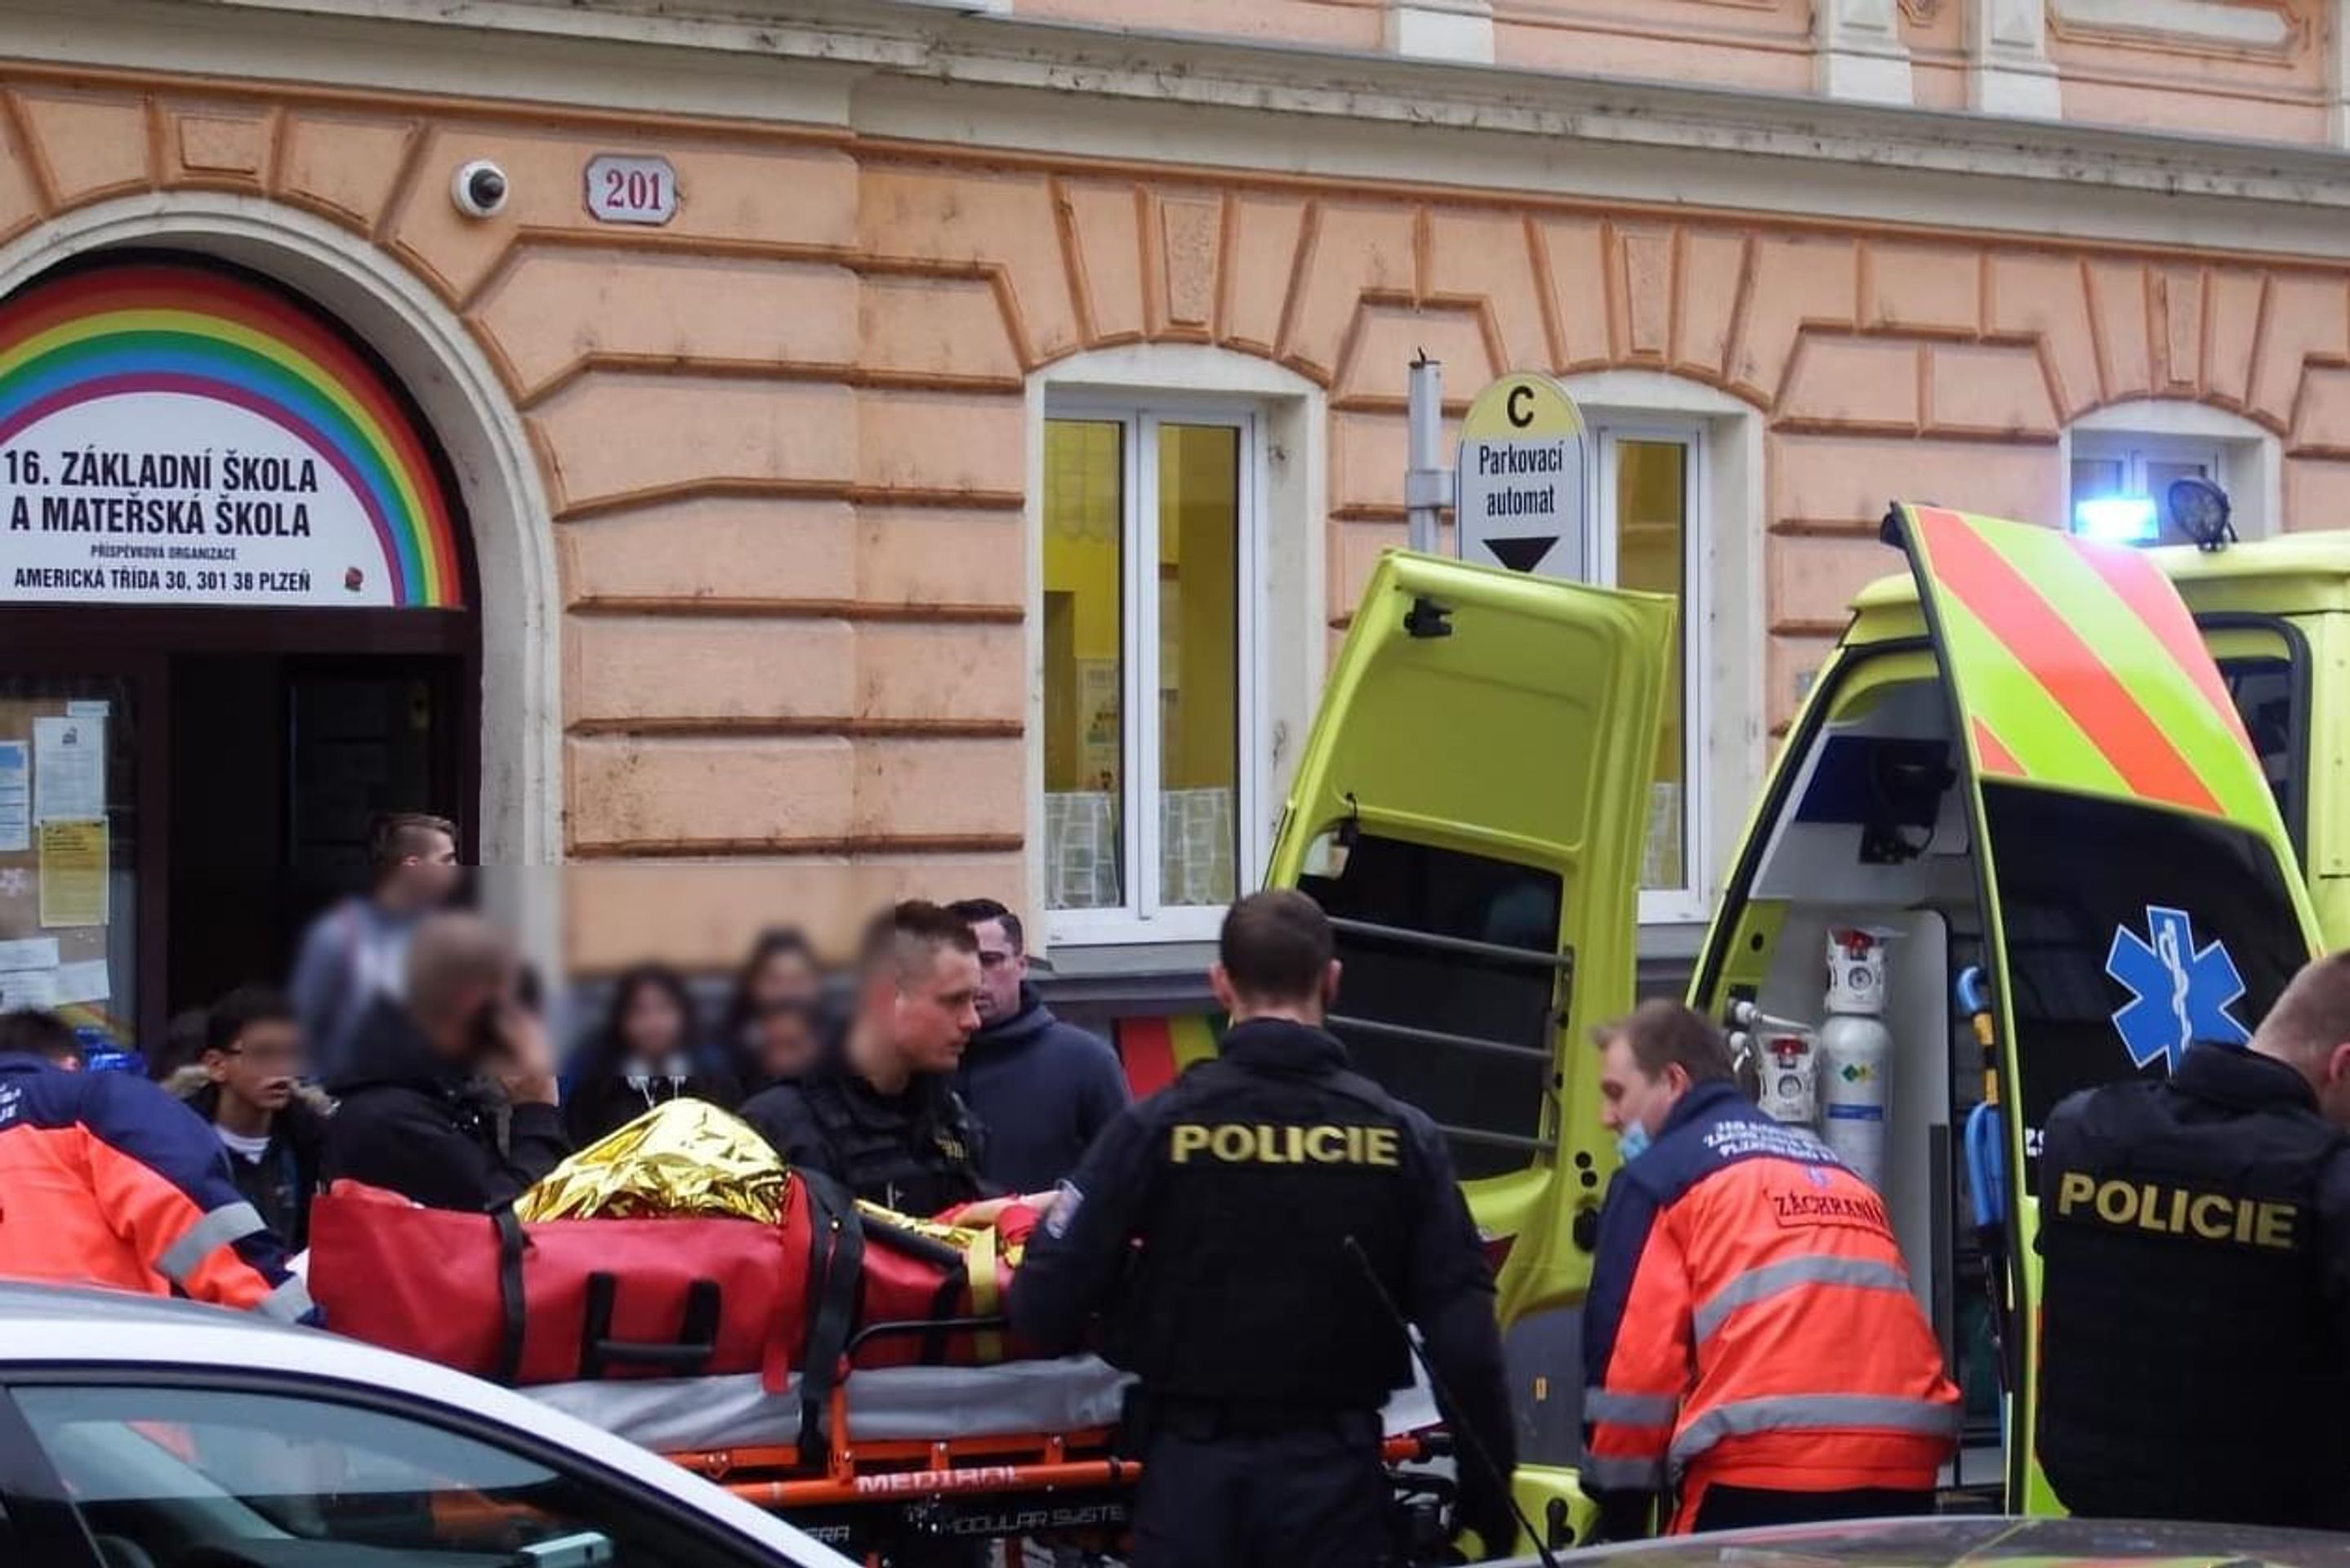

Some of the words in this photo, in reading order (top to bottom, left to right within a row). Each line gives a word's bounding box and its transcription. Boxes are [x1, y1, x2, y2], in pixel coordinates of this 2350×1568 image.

[606, 169, 662, 210] 201
[1507, 385, 1534, 428] C
[4, 450, 50, 486] 16.
[61, 444, 212, 489] ZÁKLADNÍ
[223, 449, 318, 492] ŠKOLA
[1478, 440, 1563, 475] Parkovací
[11, 495, 30, 531] A
[42, 492, 204, 534] MATEŘSKÁ
[215, 494, 310, 537] ŠKOLA
[1487, 485, 1554, 516] automat
[168, 546, 236, 560] ORGANIZACE
[15, 566, 105, 588] AMERICKÁ
[110, 565, 159, 590] TŘÍDA
[197, 572, 226, 590] 301
[234, 572, 253, 590] 38
[259, 569, 310, 591] PLZEŇ
[1171, 1124, 1399, 1166] POLICIE
[2058, 1172, 2299, 1249] POLICIE
